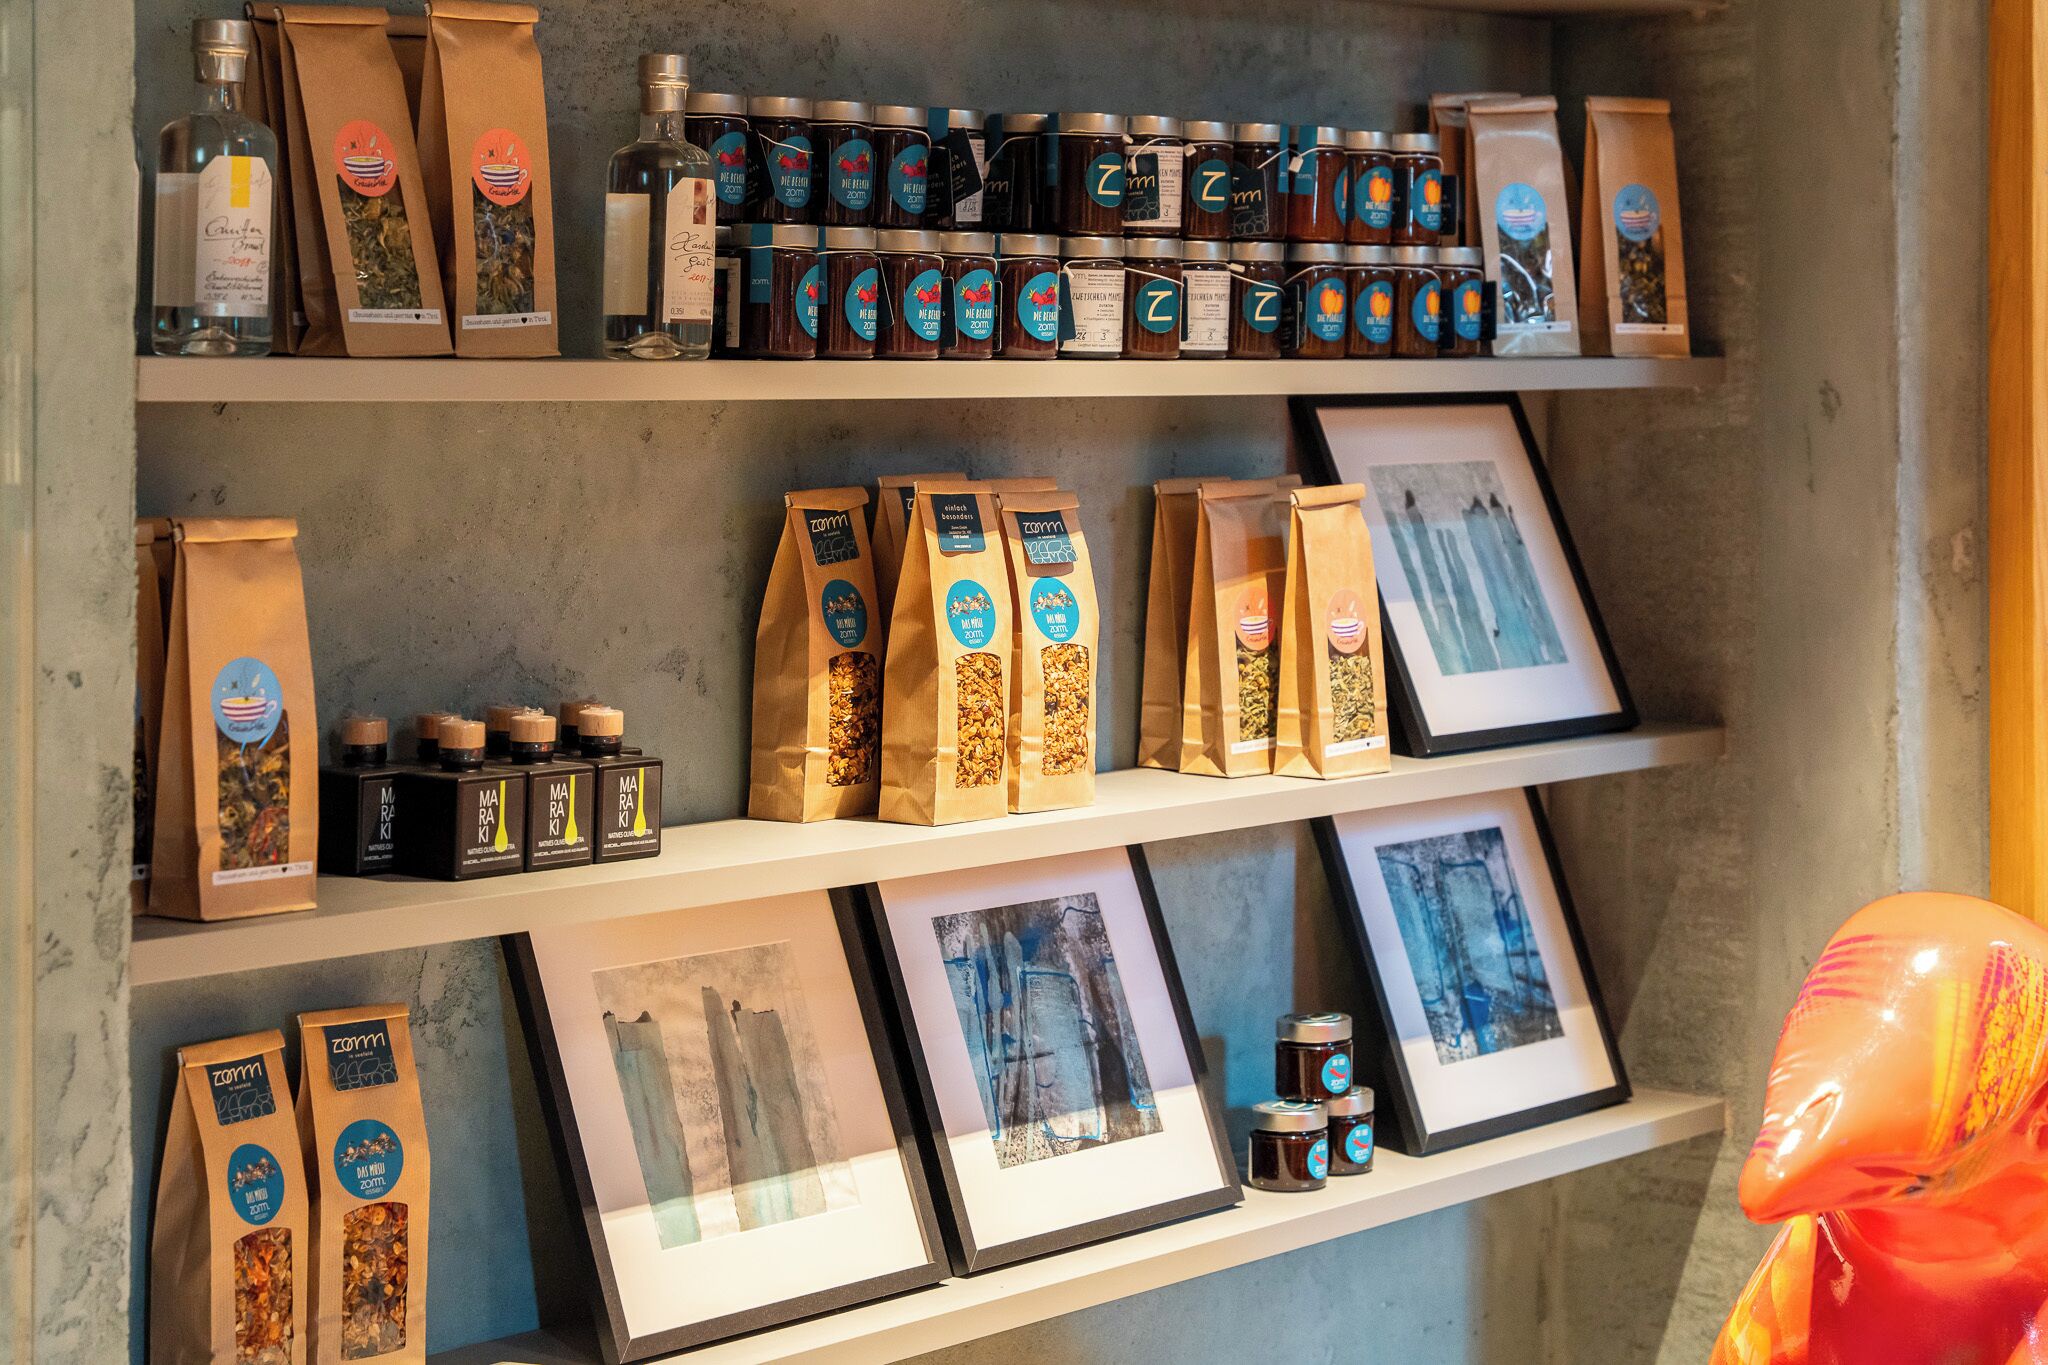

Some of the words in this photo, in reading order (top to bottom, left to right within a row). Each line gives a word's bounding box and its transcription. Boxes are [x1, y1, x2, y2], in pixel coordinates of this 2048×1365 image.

[965, 309, 975, 319] DIE
[941, 512, 974, 520] besonders
[944, 504, 968, 512] einfach
[550, 782, 569, 801] MA
[619, 775, 638, 793] MA
[479, 789, 499, 807] MA
[619, 793, 634, 811] RA
[479, 807, 495, 826] RA
[549, 800, 565, 819] RA
[549, 818, 559, 836] KI
[618, 810, 629, 828] KI
[380, 822, 391, 840] KI
[478, 825, 489, 844] KI
[356, 1165, 369, 1179] DAS
